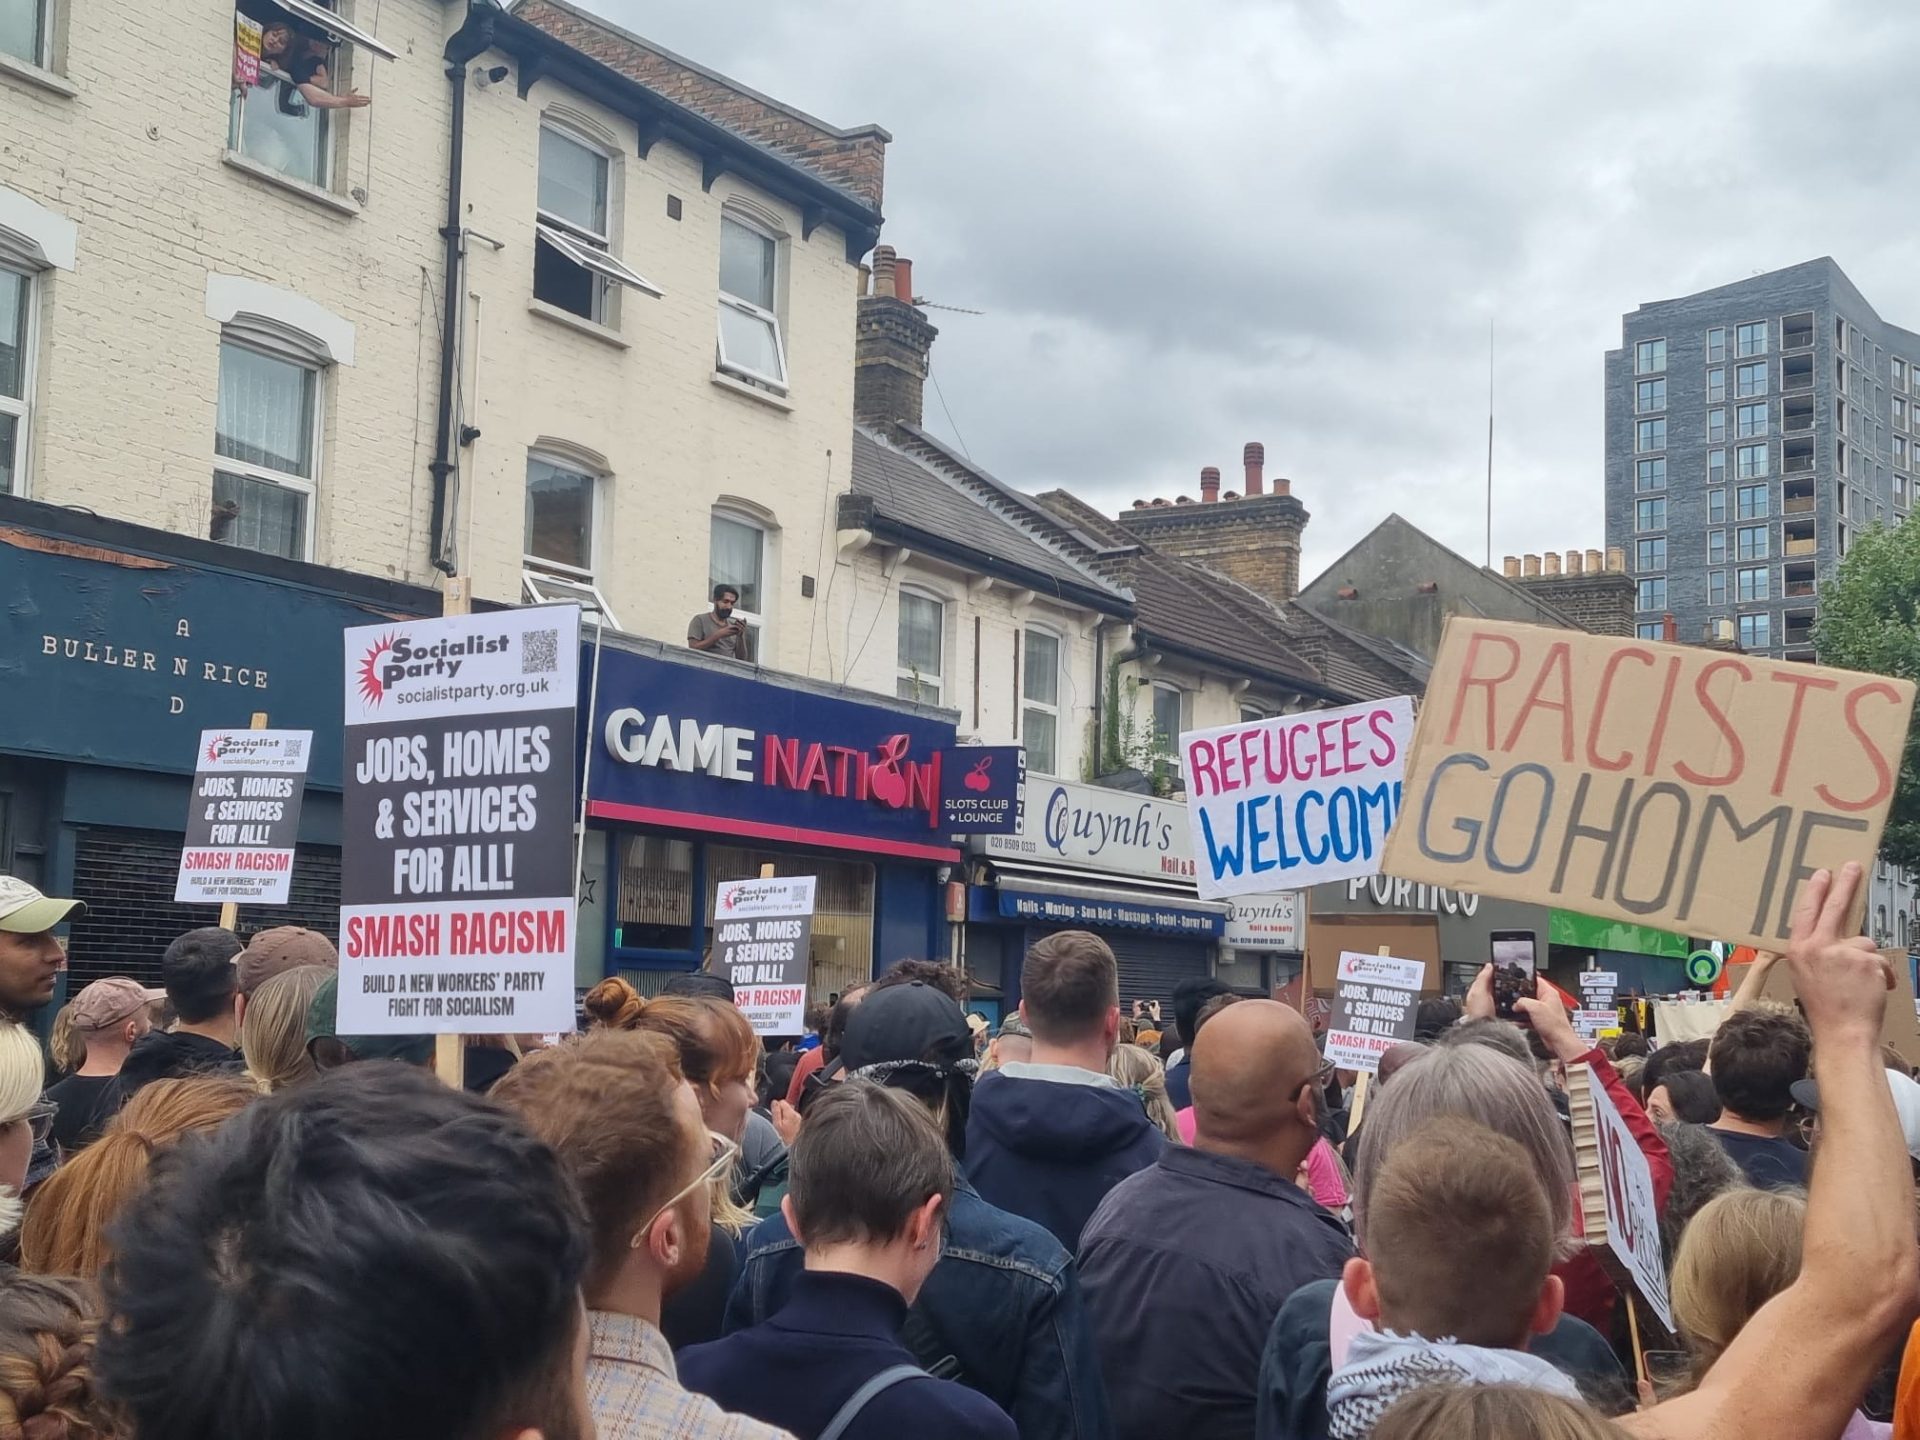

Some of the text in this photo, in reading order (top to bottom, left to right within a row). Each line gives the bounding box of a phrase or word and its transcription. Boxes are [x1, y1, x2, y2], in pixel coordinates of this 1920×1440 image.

[391, 634, 510, 663] Socialist
[42, 635, 157, 671] BULLER
[203, 662, 268, 689] RICE
[397, 678, 550, 705] socialistparty.org.uk
[1444, 633, 1901, 811] RACISTS
[223, 737, 280, 747] Socialist
[605, 707, 755, 782] GAME
[356, 725, 551, 785] JOBS, HOMES
[1189, 710, 1396, 797] REFUGEES
[199, 777, 294, 798] JOBS, HOMES
[204, 801, 284, 821] & SERVICES
[375, 784, 537, 839] & SERVICES
[945, 799, 1009, 809] SLOTS CLUB
[958, 812, 1003, 823] LOUNGE
[1045, 786, 1172, 856] Quynh's
[210, 824, 270, 845] FOR ALL!
[1199, 780, 1402, 880] WELCOM
[990, 836, 1036, 853] 020 8509 0333
[185, 852, 290, 871] SMASH RACISM
[394, 843, 514, 895] FOR ALL!
[1161, 855, 1178, 874] Nail
[347, 910, 565, 958] SMASH RACISM
[719, 921, 801, 942] JOBS, HOMES
[725, 942, 794, 963] & SERVICES
[362, 971, 545, 994] BUILD A NEW WORKERS' PARTY
[730, 964, 784, 984] FOR ALL!
[754, 989, 801, 1007] RACISM
[1340, 984, 1412, 1007] JOBS, HOMES
[388, 996, 515, 1017] FIGHT FOR SOCIALISM
[1344, 1001, 1405, 1022] & SERVICES
[1349, 1016, 1395, 1036] FOR ALL!
[1329, 1033, 1366, 1049] SMASH
